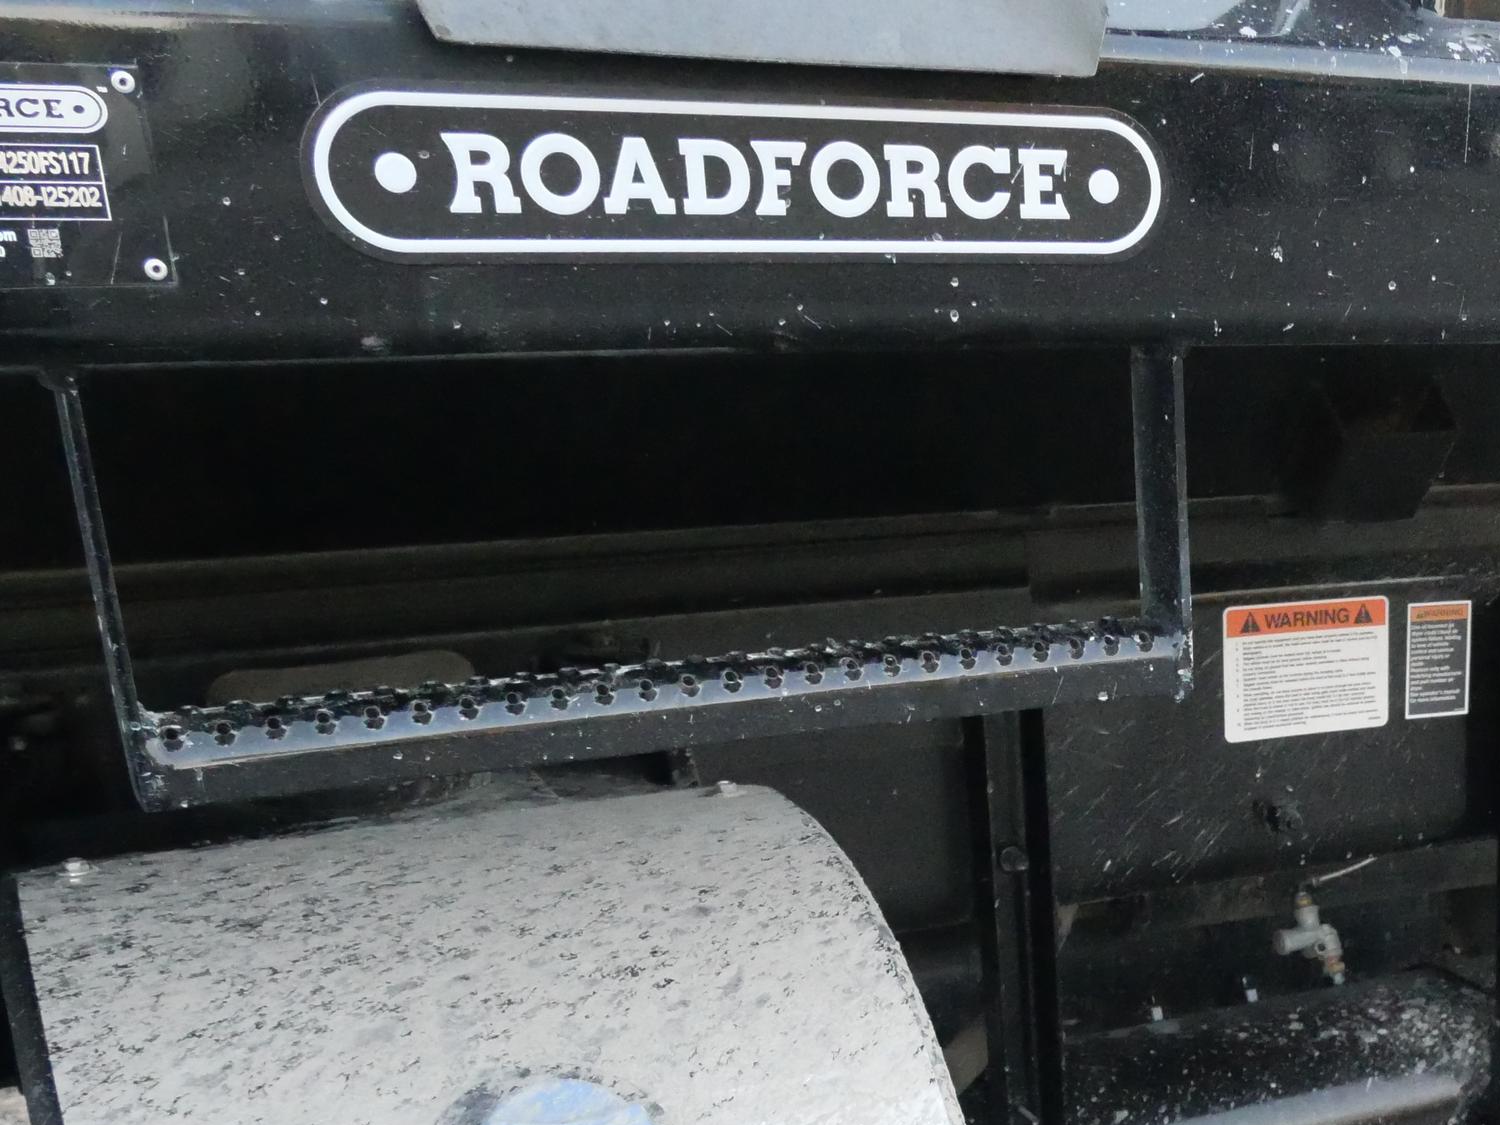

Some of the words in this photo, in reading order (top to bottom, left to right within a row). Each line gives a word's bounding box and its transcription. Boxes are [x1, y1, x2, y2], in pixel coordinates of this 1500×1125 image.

[440, 131, 1071, 220] ROADFORCE
[0, 185, 102, 207] 408-125202
[1264, 607, 1350, 629] WARNING
